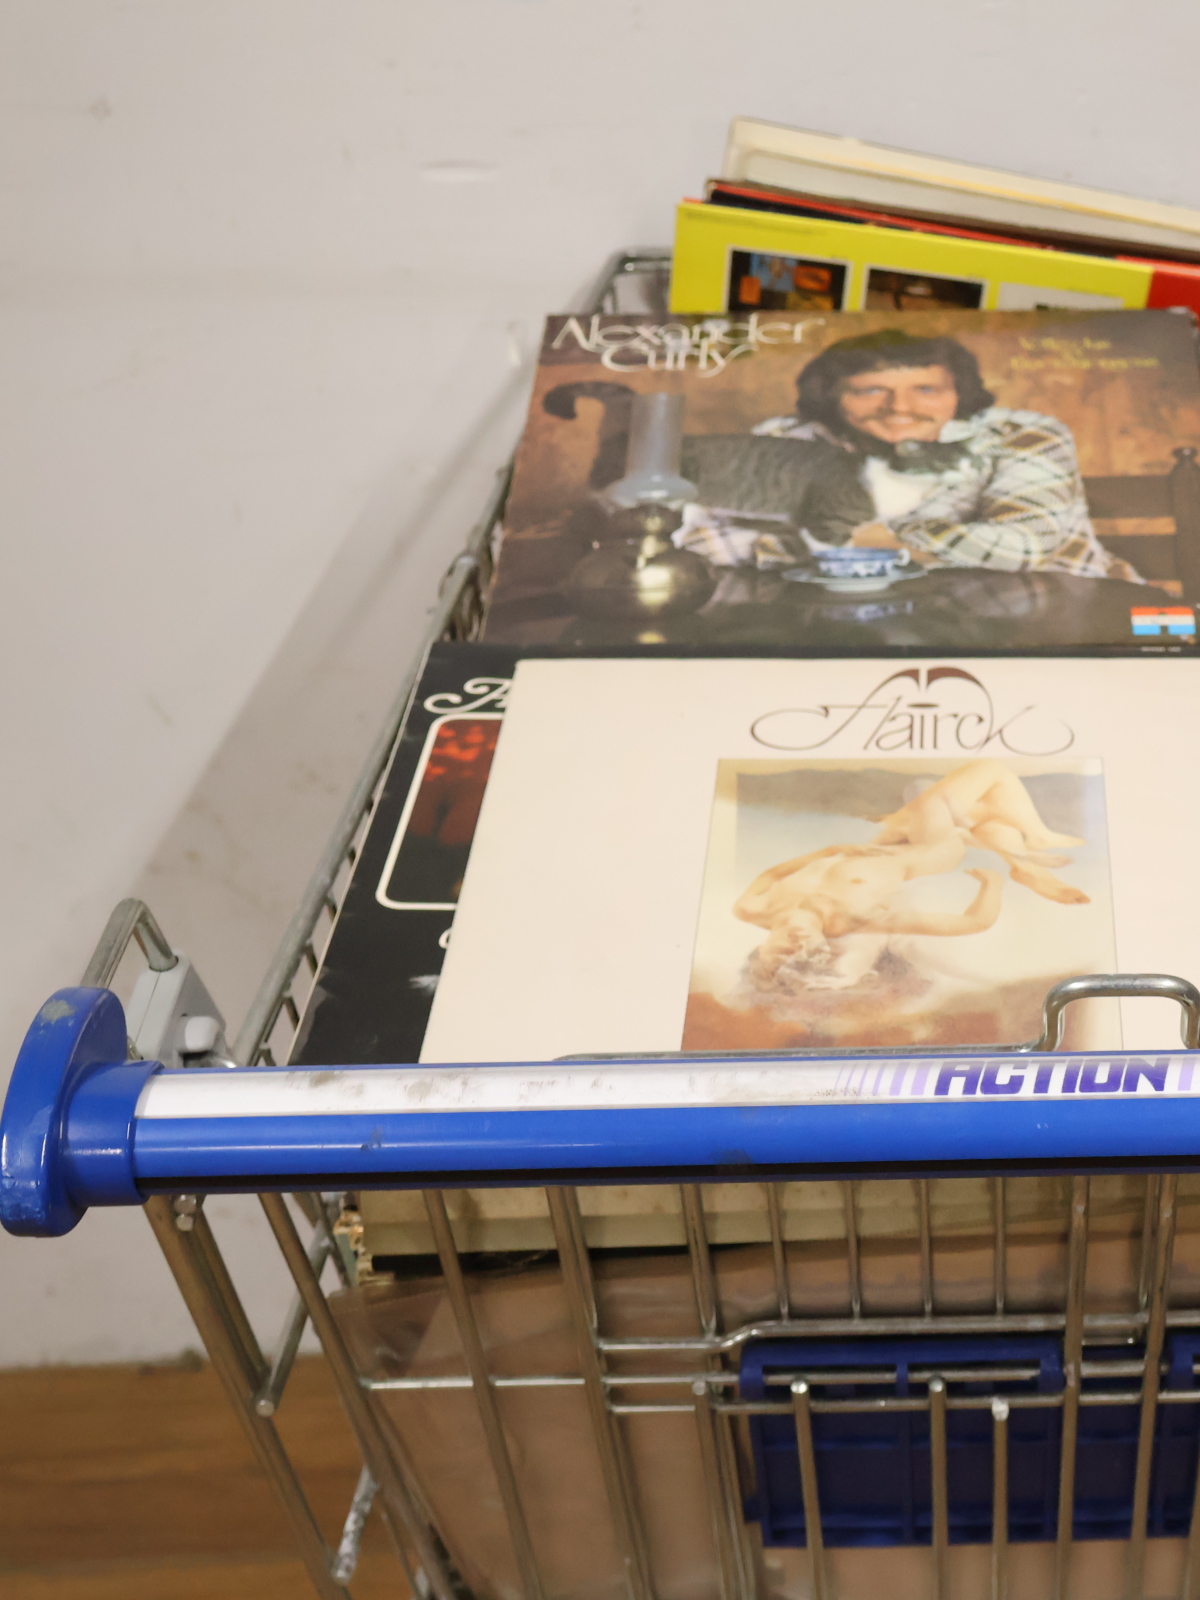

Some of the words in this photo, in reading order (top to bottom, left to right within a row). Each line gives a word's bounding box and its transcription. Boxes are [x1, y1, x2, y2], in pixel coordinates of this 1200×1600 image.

[552, 312, 826, 352] Alexander
[601, 338, 760, 378] Curly
[749, 665, 1076, 758] Flairck
[933, 1057, 1171, 1096] ACTION
